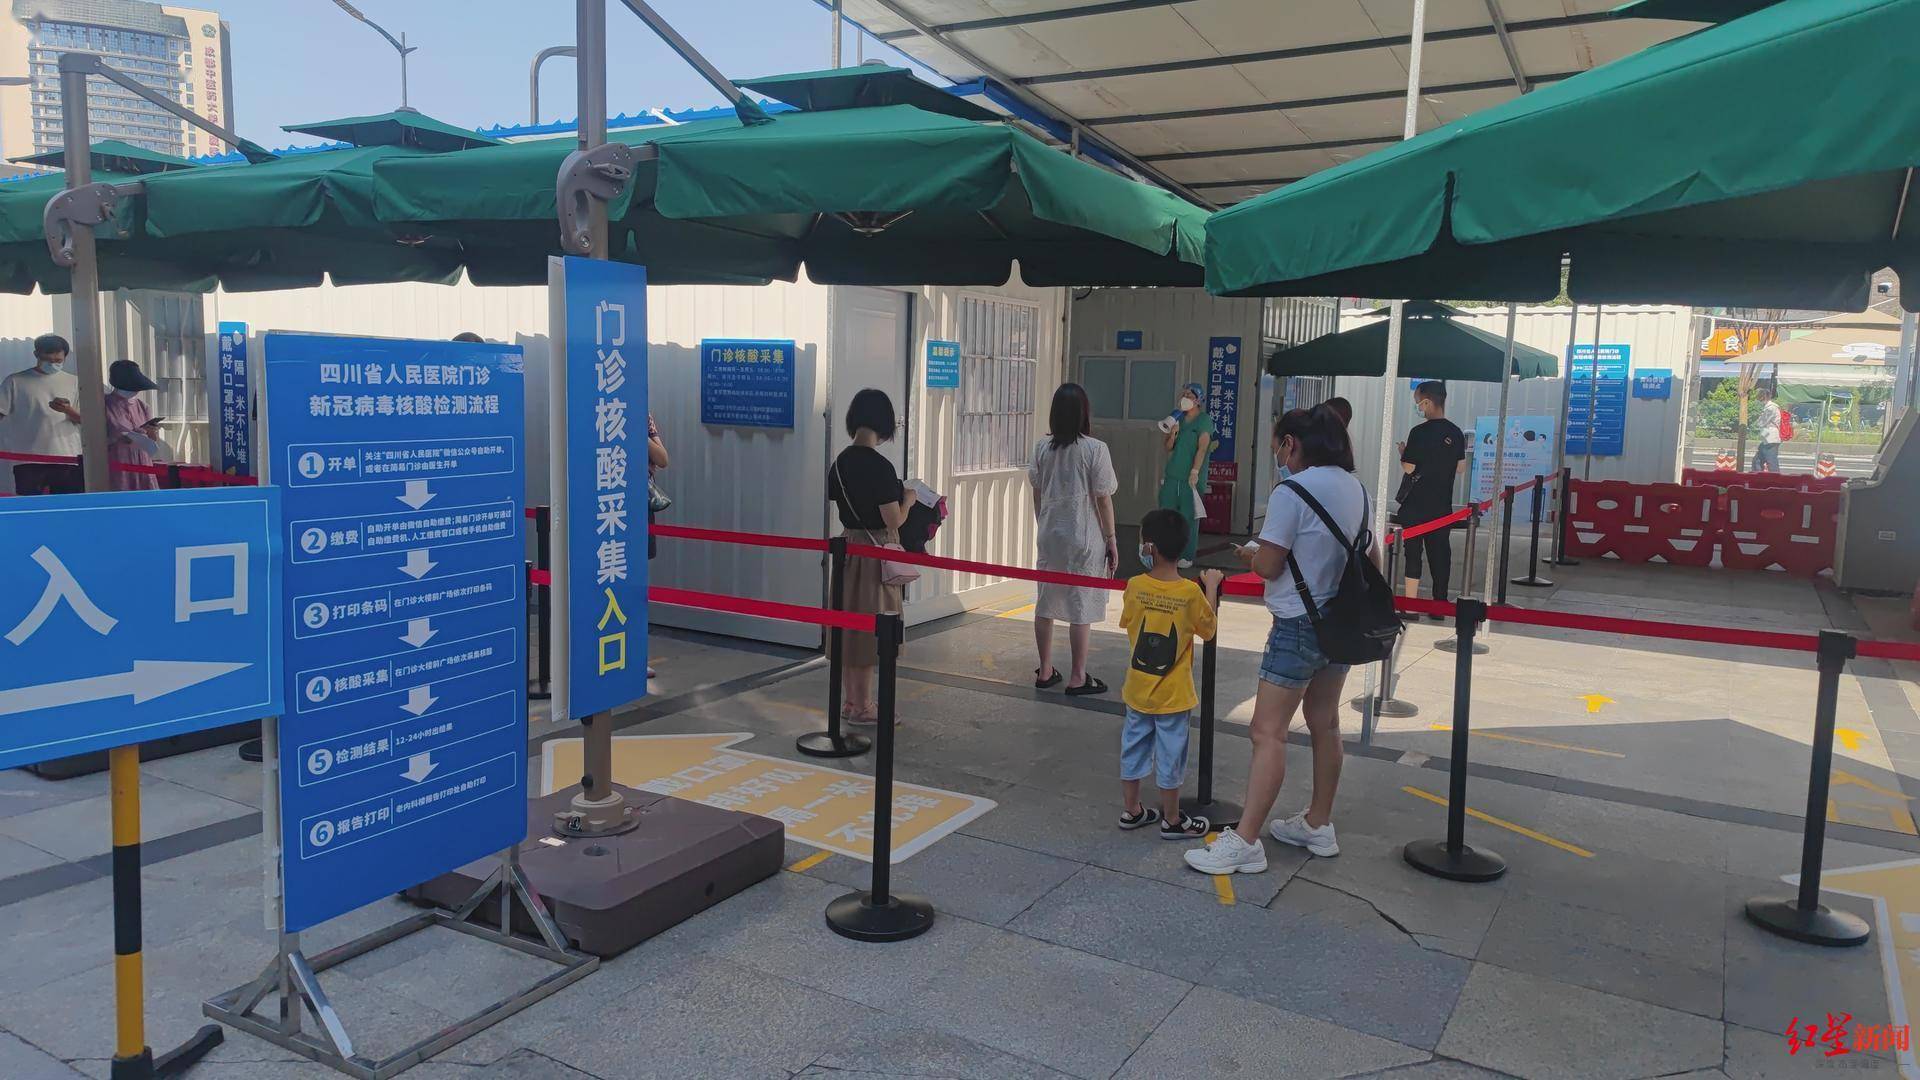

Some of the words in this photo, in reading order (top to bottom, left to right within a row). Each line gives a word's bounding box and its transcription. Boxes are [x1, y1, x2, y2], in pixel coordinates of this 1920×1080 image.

[711, 347, 784, 364] 门诊核酸采集
[320, 363, 491, 386] 四川省人民医院门诊
[221, 336, 236, 458] 戴好口罩排好队
[309, 394, 500, 417] 新冠病毒核酸检测流程
[1221, 363, 1236, 439] 隔一米不扎堆
[233, 359, 247, 464] 隔一米不扎堆
[328, 456, 357, 471] 开单
[595, 299, 627, 677] 门诊核酸采集入口
[330, 530, 359, 546] 缴费
[4, 542, 249, 646] 入口
[332, 598, 388, 621] 打印条码
[334, 669, 389, 693] 核酸采集
[395, 722, 454, 746] 12-24小时出结果
[335, 738, 389, 765] 检测结果
[337, 806, 390, 836] 报告打印
